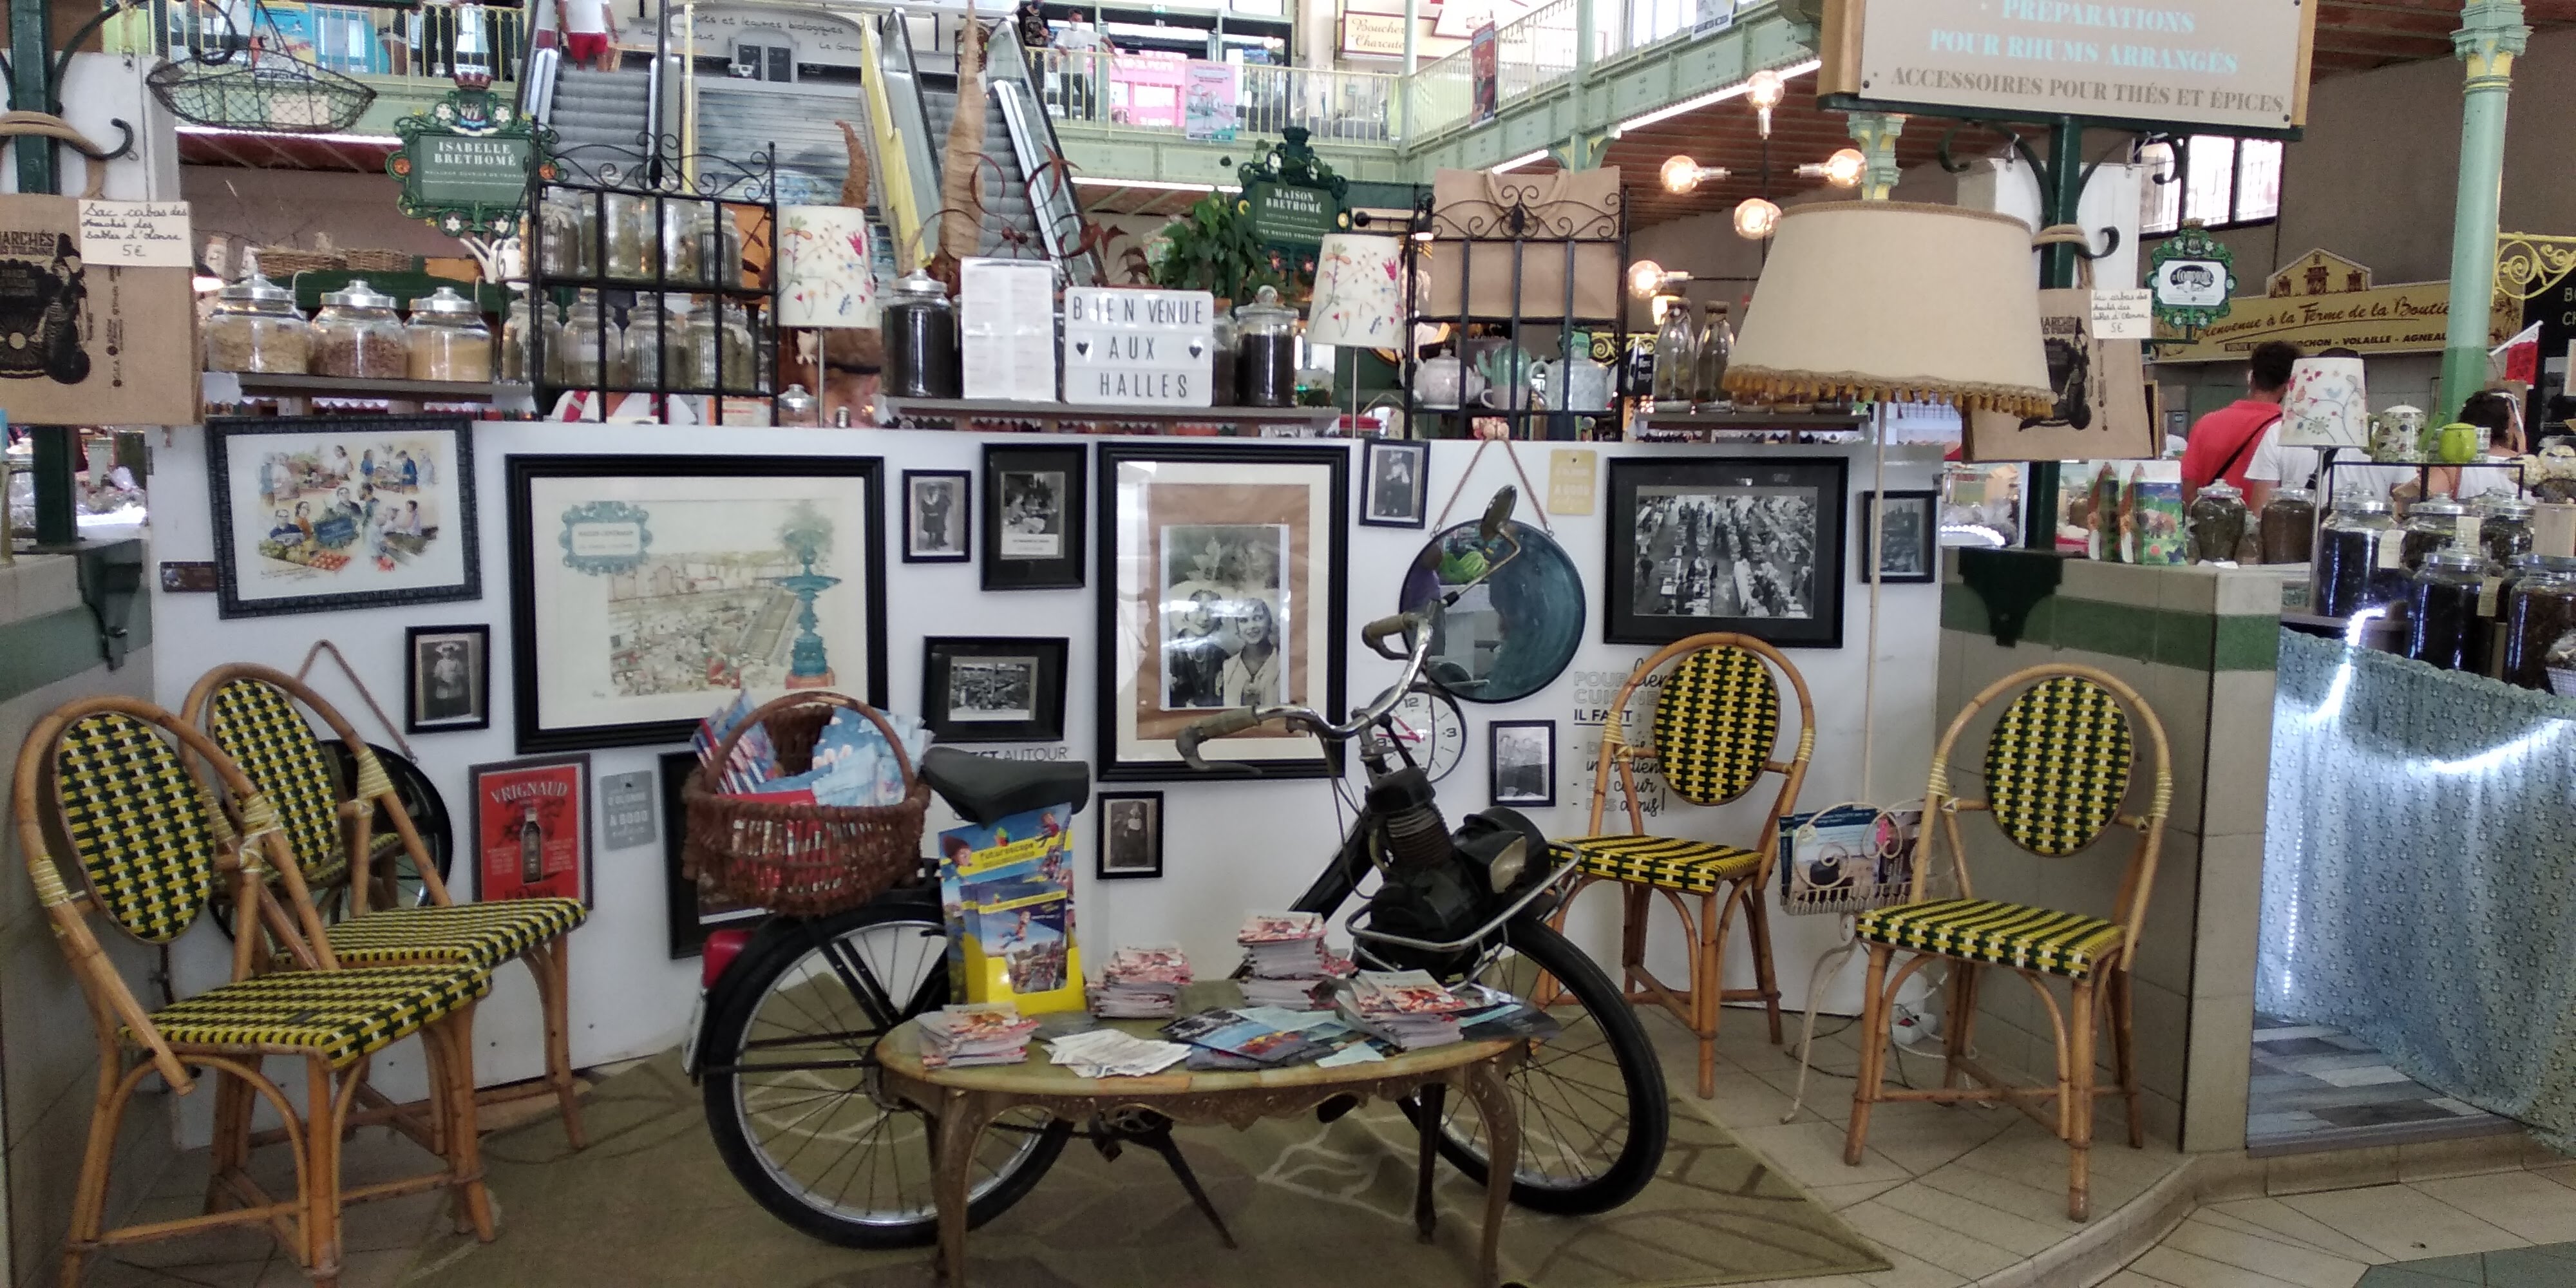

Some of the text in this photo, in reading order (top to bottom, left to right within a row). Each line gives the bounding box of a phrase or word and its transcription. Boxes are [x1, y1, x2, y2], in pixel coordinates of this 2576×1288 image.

[1352, 18, 1405, 33] Boucher
[1355, 35, 1405, 48] Charcute
[1931, 29, 2238, 74] POUR RHUMS ARRANGÉS
[1891, 67, 2284, 112] ACCESSOIRES POUR THÉS ET ÉPICES
[439, 142, 511, 153] ISABELLE
[434, 153, 516, 166] BRETHOMÉ
[1274, 188, 1314, 202] MAISON
[83, 203, 187, 217] Sac cabas des
[1266, 198, 1322, 213] BRETHOMÉ
[134, 220, 153, 229] des
[0, 229, 54, 247] ARCHÉS
[123, 245, 146, 257] 5€
[2267, 314, 2276, 327] à
[2280, 311, 2296, 324] la
[2300, 302, 2343, 324] Ferme
[2349, 305, 2366, 319] de
[2371, 303, 2387, 317] la
[1109, 336, 1155, 360] AUX
[2296, 337, 2331, 348] OCHON
[2342, 335, 2391, 346] VOLAILLE
[1100, 372, 1188, 398] HALLES
[1404, 697, 1419, 708] 12
[1574, 709, 1633, 722] IL FAT
[1446, 727, 1457, 738] 3
[490, 781, 569, 804] VRIGNAUD
